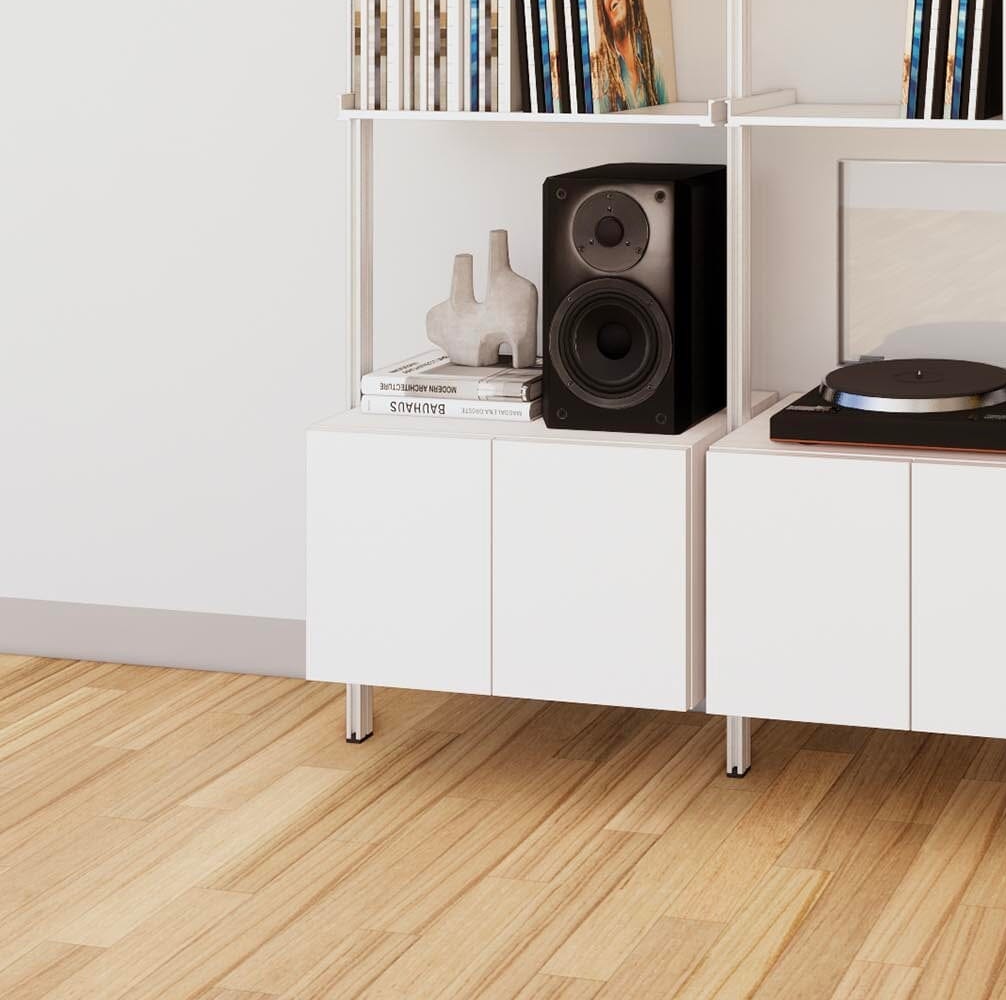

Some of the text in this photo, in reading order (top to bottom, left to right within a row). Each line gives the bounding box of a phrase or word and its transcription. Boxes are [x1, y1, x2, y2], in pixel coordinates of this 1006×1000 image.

[380, 383, 457, 394] MODERN ARCHITECTURE
[390, 401, 446, 415] BAUHAUS
[484, 408, 522, 416] MAGDALENA
